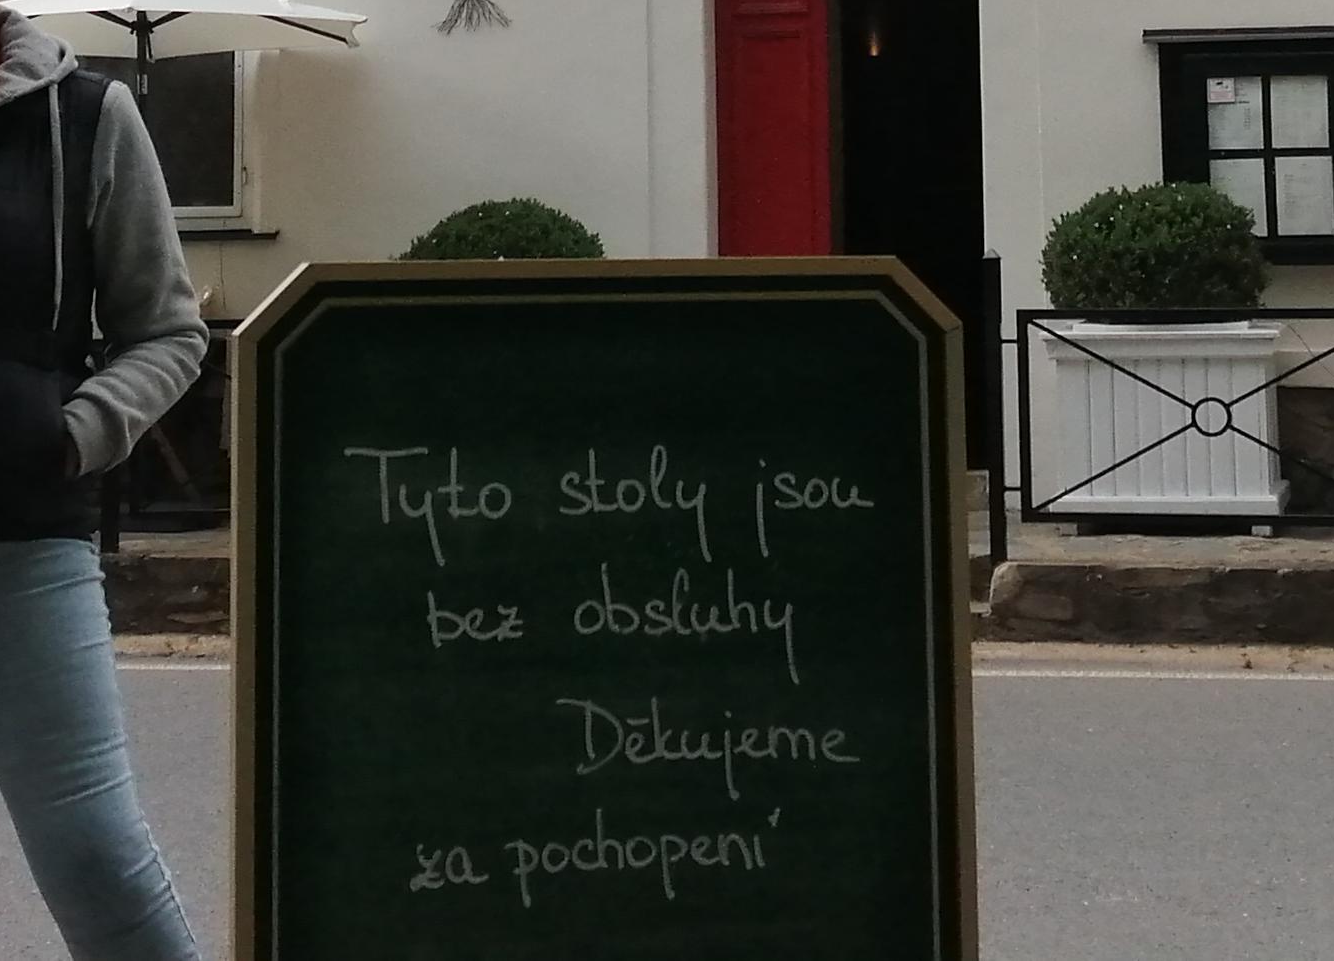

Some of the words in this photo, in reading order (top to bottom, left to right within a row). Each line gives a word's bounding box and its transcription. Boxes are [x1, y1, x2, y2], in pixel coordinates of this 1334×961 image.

[343, 445, 512, 566] Tyto
[560, 444, 712, 562] stoly
[755, 460, 875, 558] jsou
[426, 591, 524, 648] bez
[574, 562, 800, 684] obsluhy
[410, 844, 489, 893] za
[505, 807, 782, 908] pochopení
